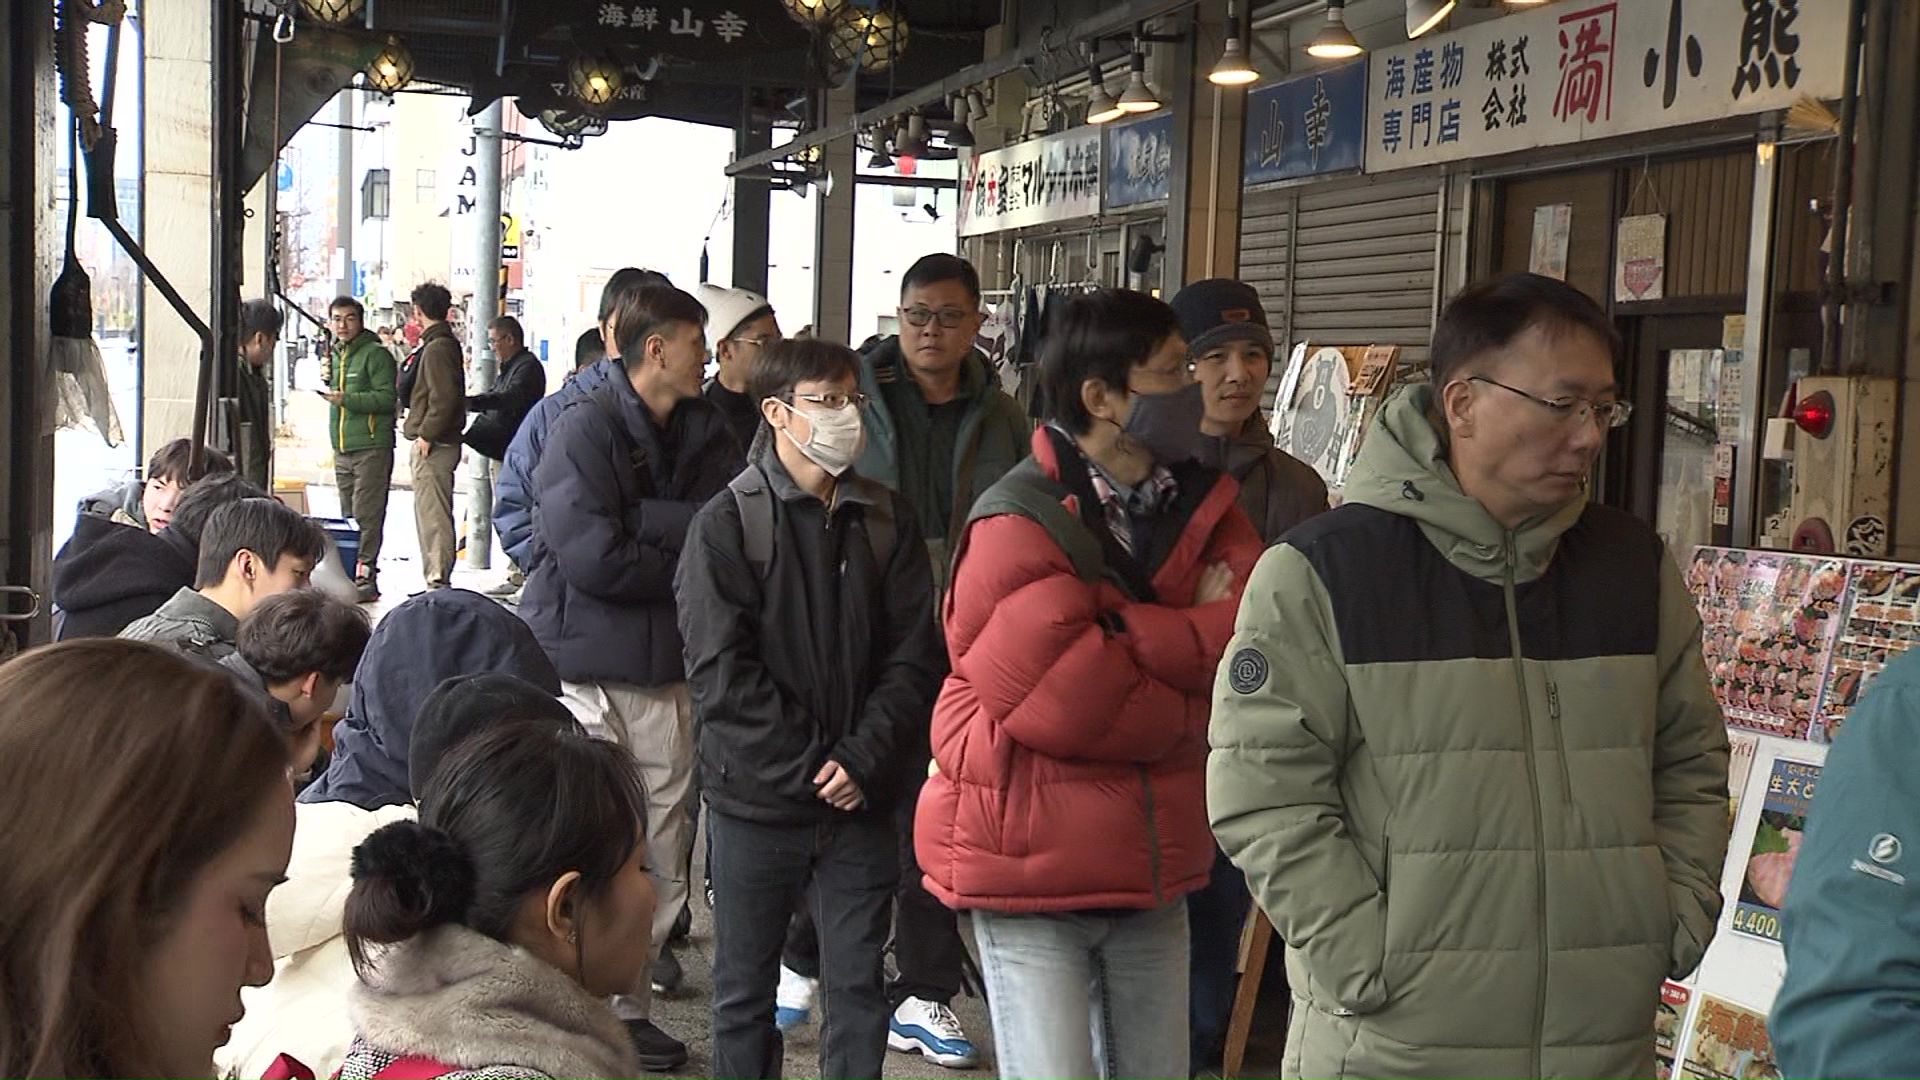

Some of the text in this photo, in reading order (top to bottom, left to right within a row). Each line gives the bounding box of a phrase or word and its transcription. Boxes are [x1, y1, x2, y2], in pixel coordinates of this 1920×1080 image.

[597, 3, 748, 43] 海鮮 山幸
[1384, 40, 1465, 100] 海産物
[1259, 77, 1332, 171] 山幸
[1381, 97, 1462, 154] 専門店
